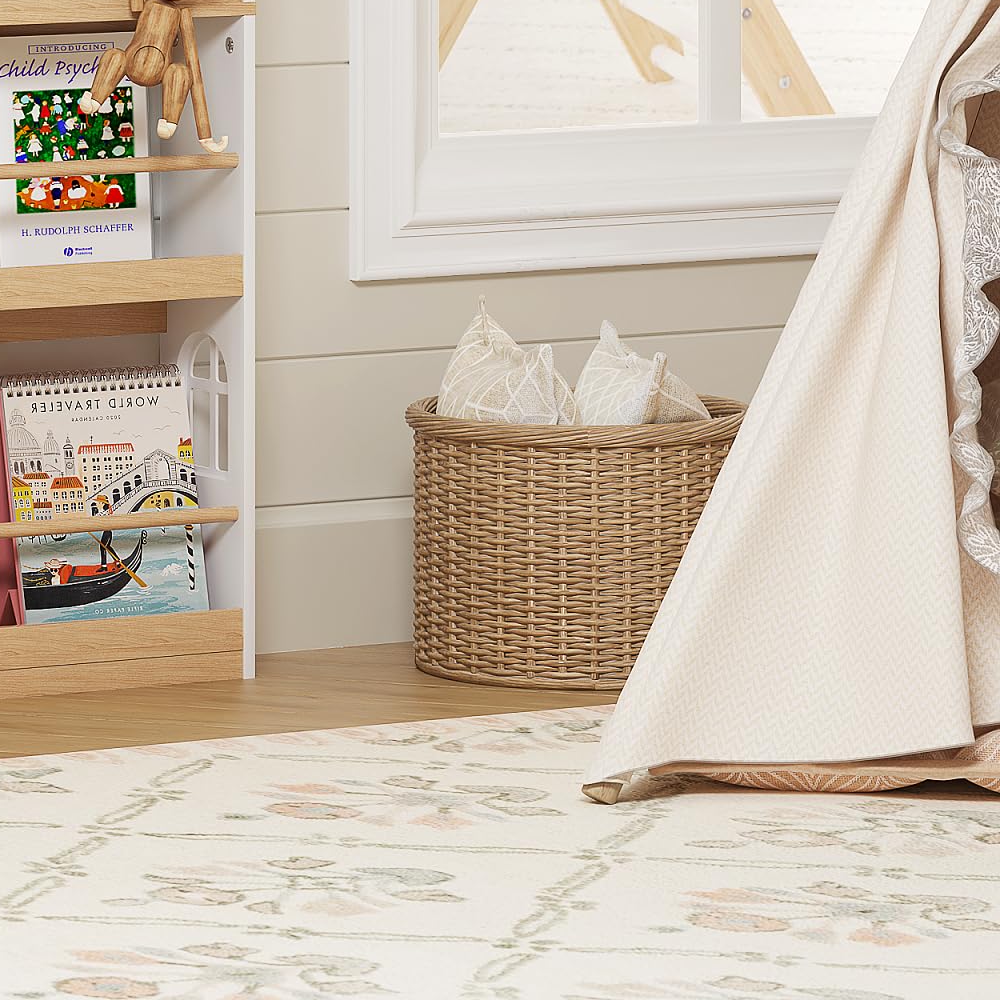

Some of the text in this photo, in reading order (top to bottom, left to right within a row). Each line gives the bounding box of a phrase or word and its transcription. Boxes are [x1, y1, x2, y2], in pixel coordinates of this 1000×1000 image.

[35, 43, 107, 52] INTRODUCING
[54, 56, 99, 84] Psych
[21, 223, 134, 237] H. RUDOLPH SCHAFFER
